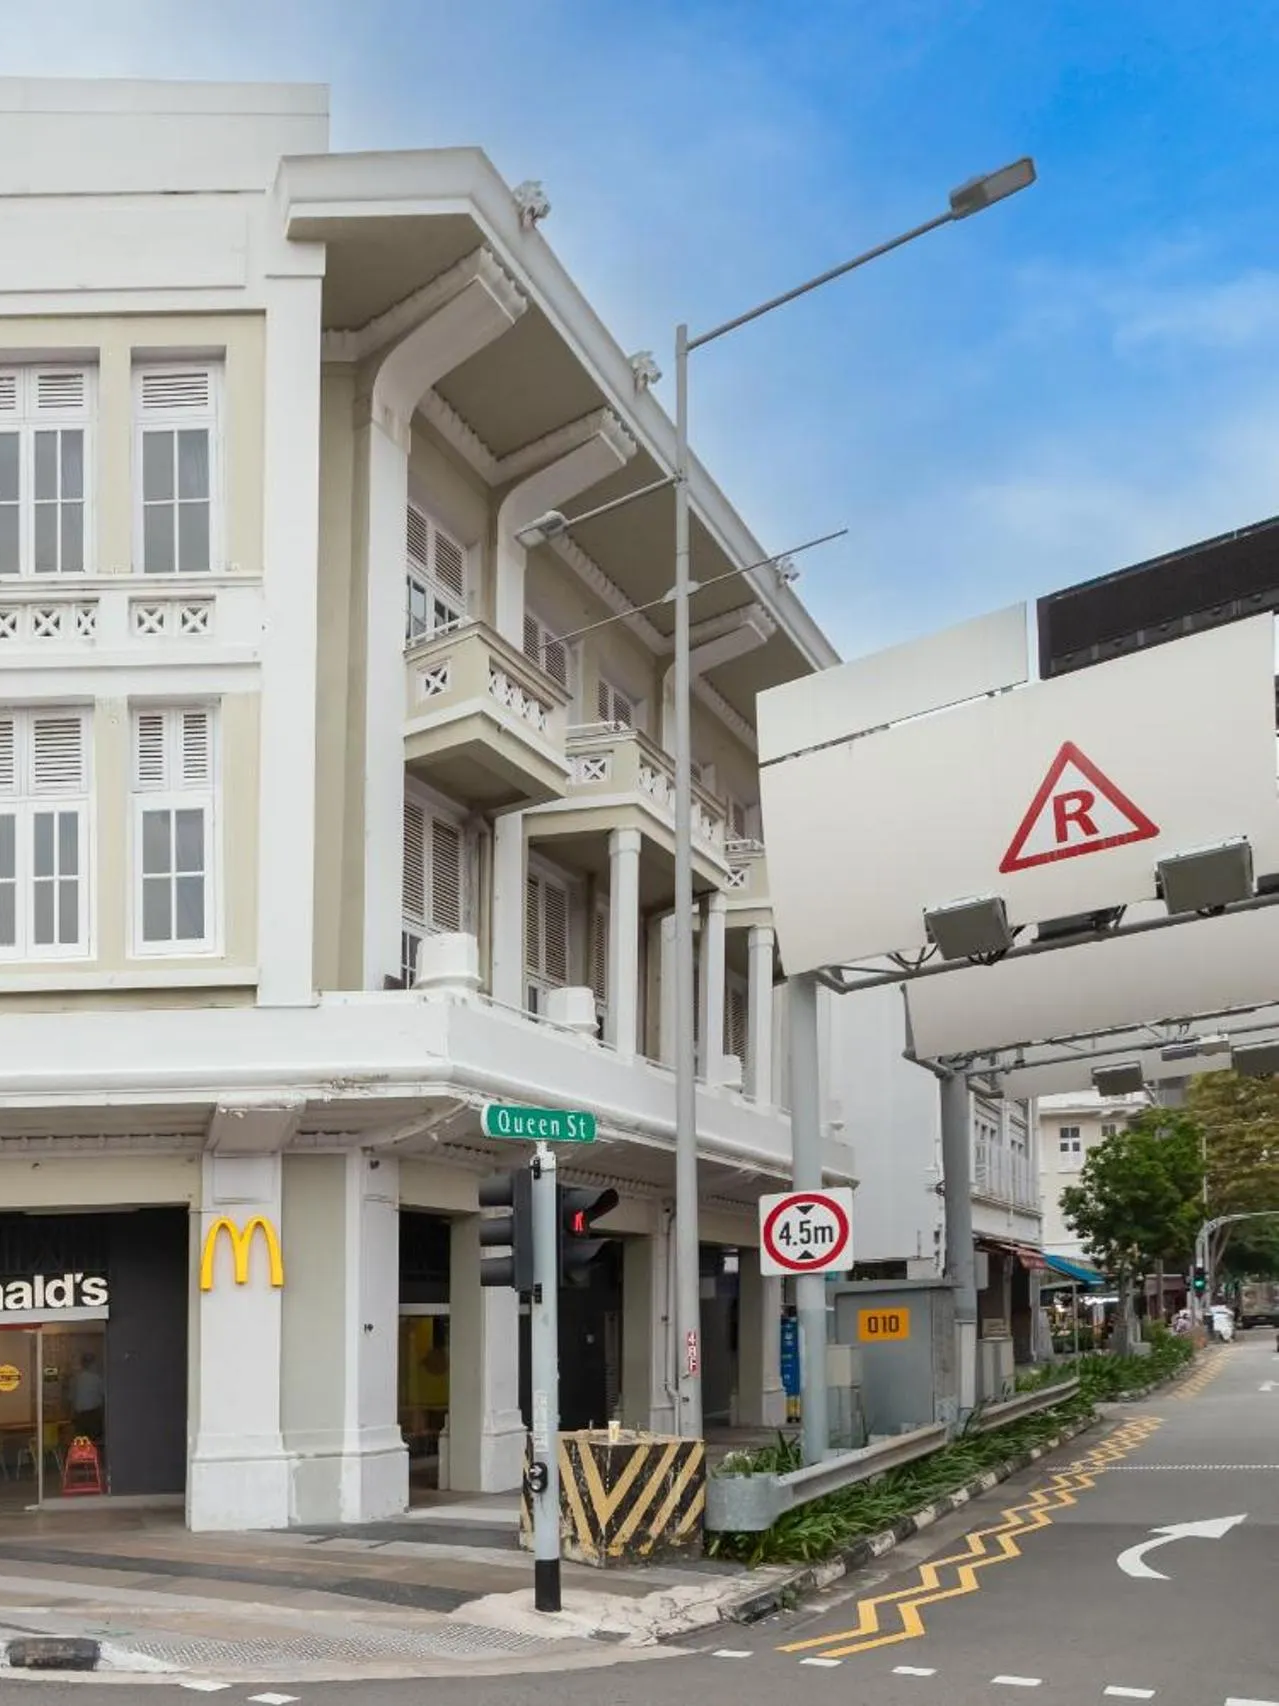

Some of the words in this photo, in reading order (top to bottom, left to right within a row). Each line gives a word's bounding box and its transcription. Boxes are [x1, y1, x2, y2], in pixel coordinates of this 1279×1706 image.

[1053, 789, 1100, 843] R
[498, 1109, 560, 1137] Queen
[566, 1115, 587, 1139] St
[779, 1220, 834, 1246] 4.5m
[867, 1315, 899, 1333] 010
